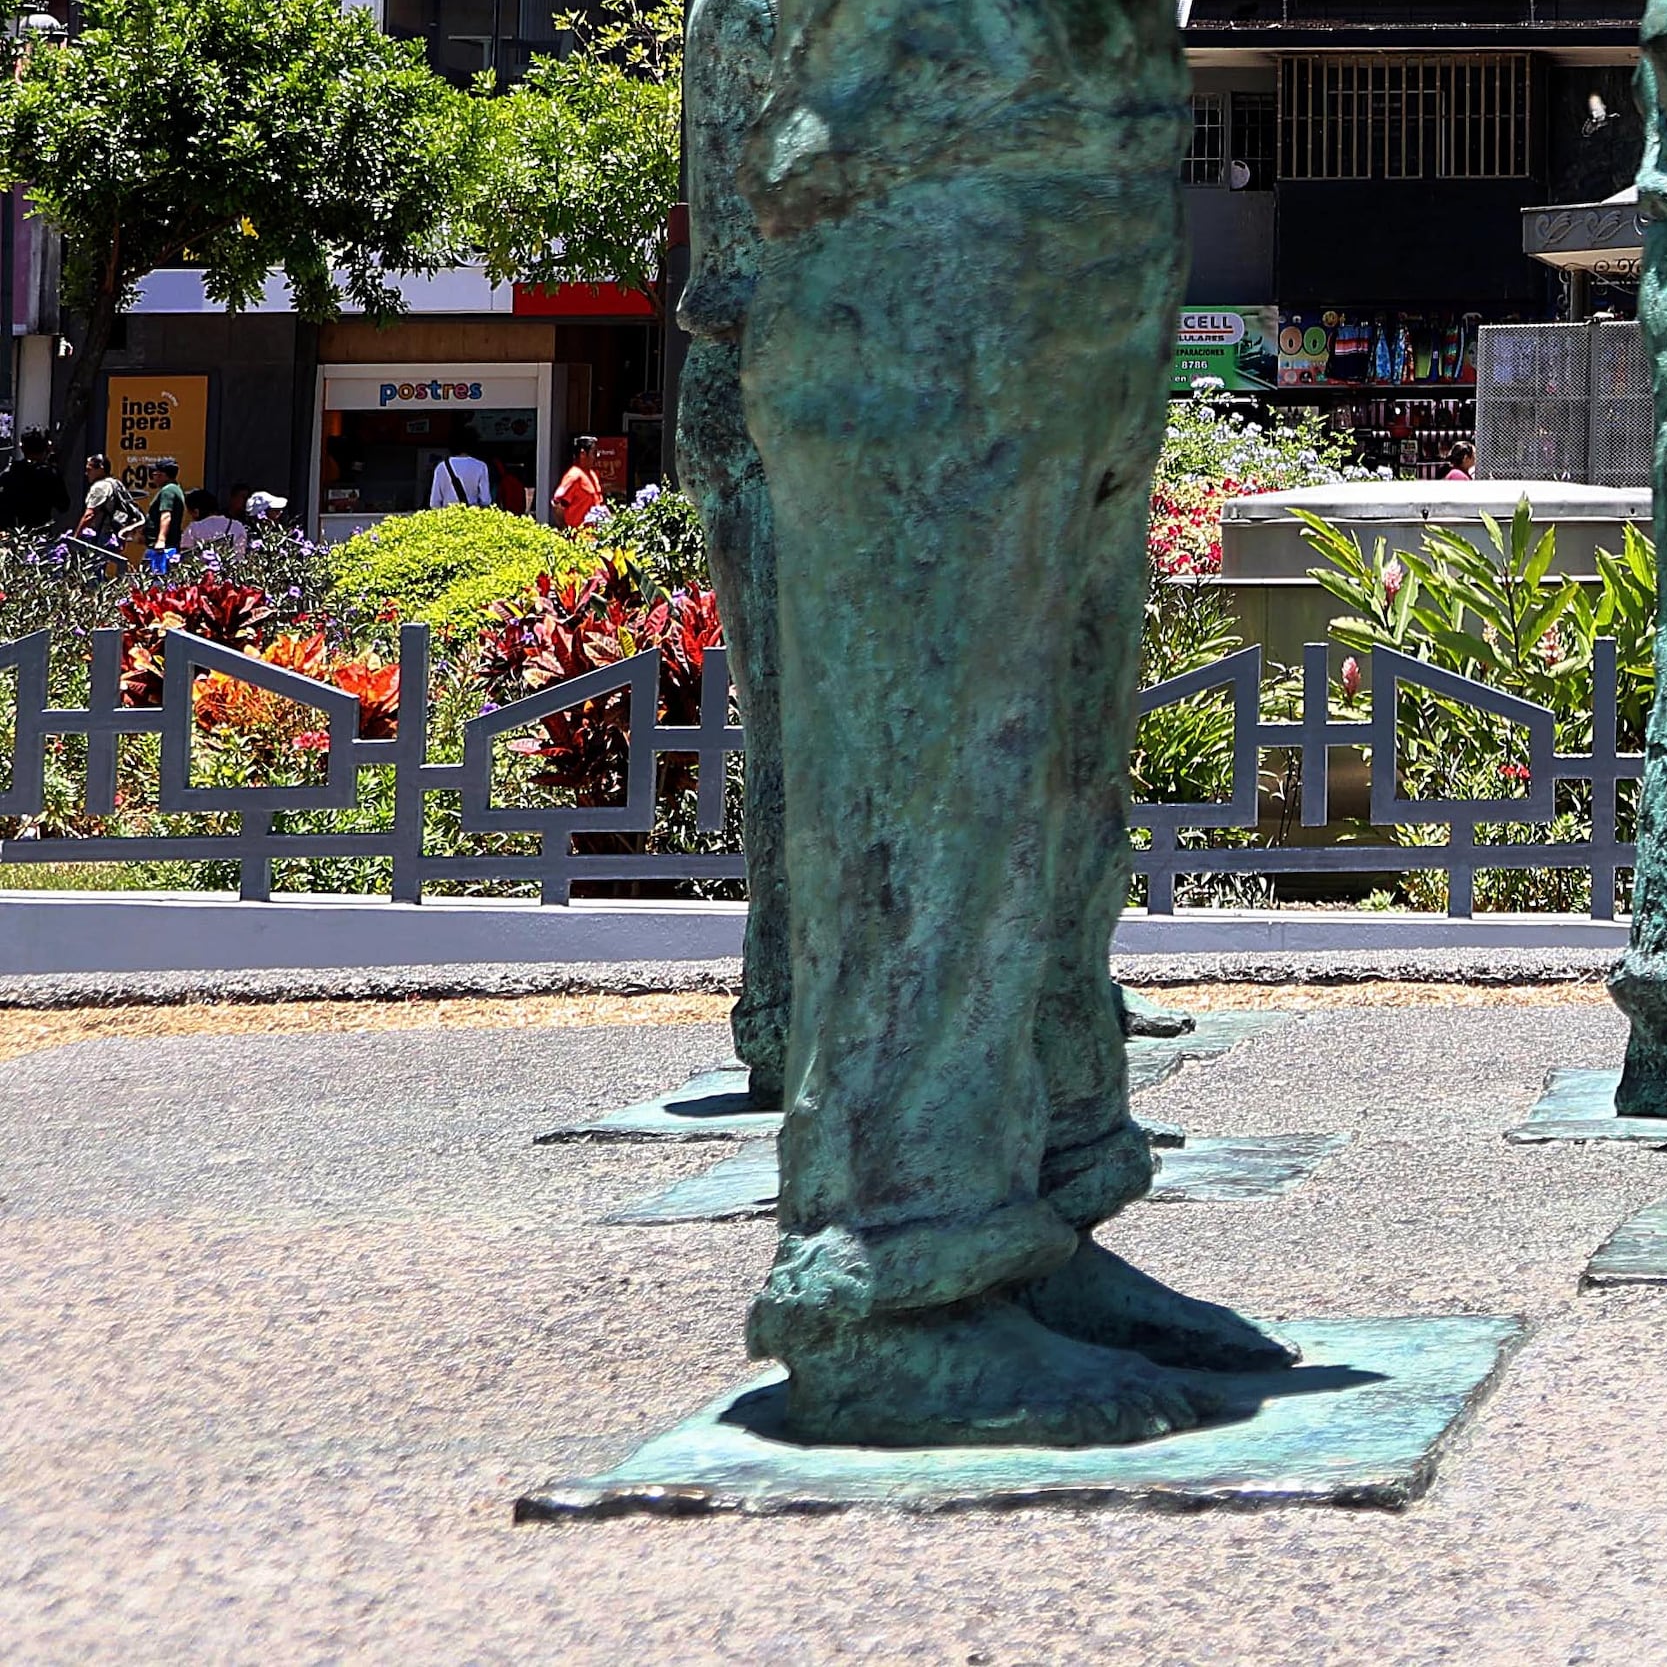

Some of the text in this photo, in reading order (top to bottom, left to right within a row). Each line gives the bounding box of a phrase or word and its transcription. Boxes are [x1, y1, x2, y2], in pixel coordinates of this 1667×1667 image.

[1181, 360, 1208, 370] 8786
[380, 380, 483, 406] postres
[122, 396, 169, 415] ines
[121, 415, 172, 436] pera
[120, 432, 148, 451] da
